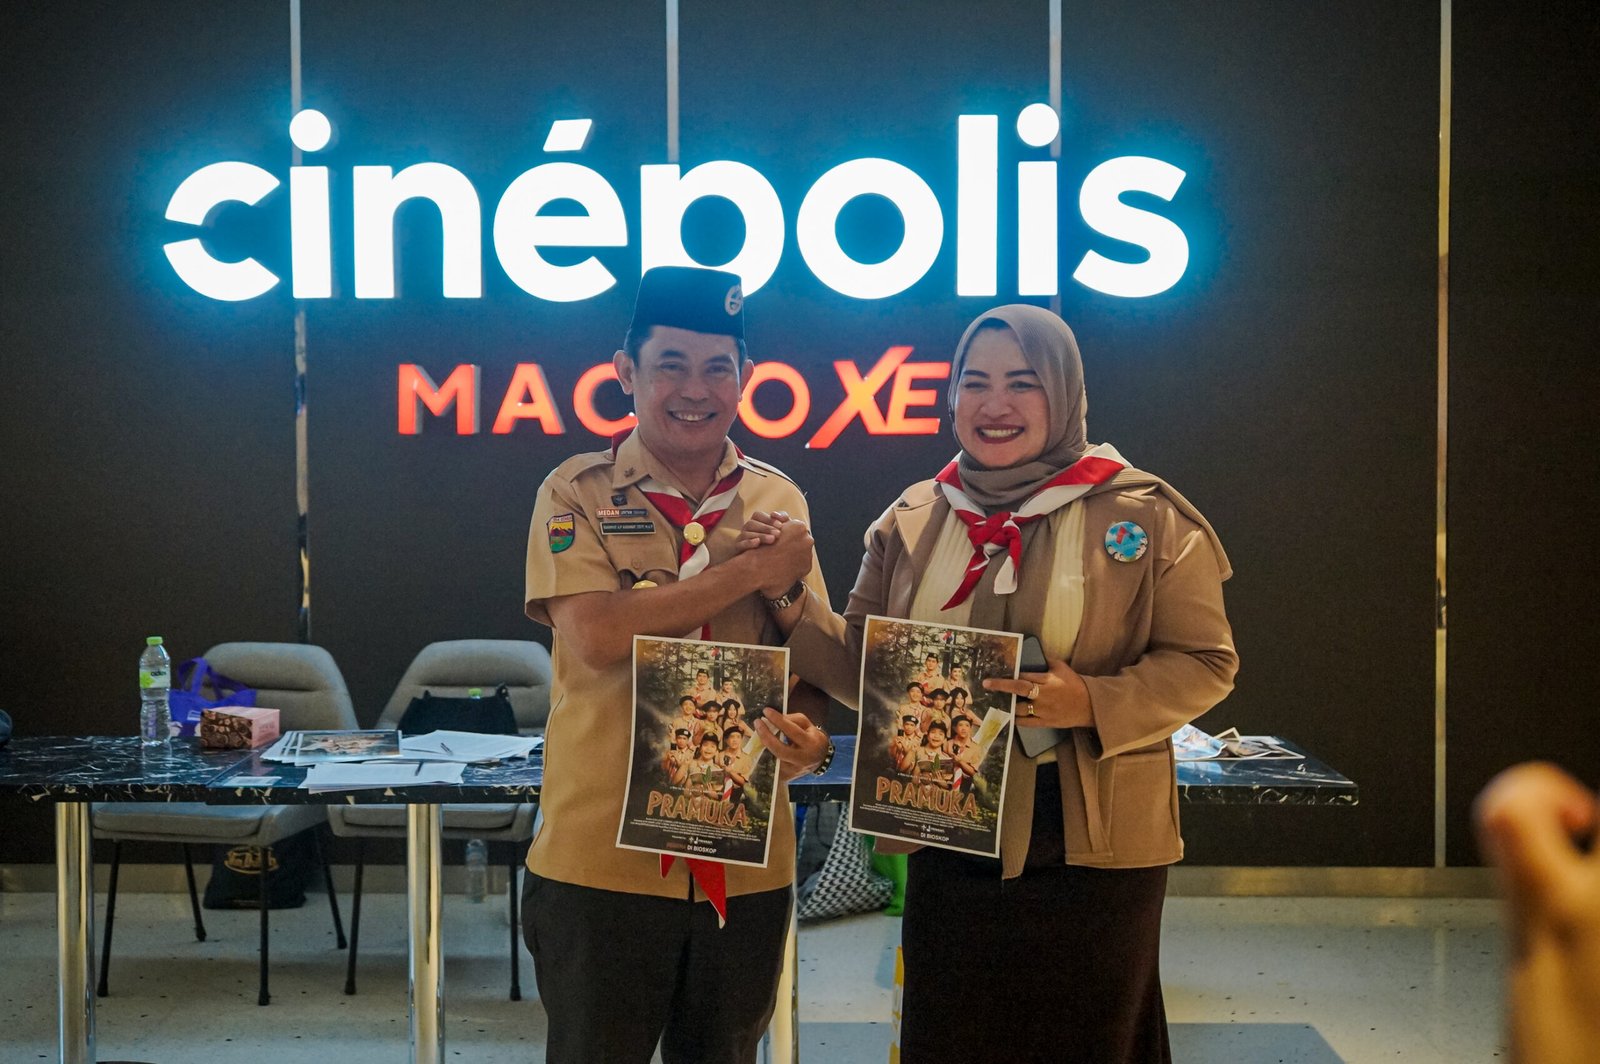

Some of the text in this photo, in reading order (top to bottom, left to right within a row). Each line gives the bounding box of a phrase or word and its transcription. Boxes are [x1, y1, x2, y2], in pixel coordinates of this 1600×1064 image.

[162, 102, 1190, 303] cinépolis
[398, 361, 811, 440] MACO
[646, 790, 747, 828] PRAMUKA
[875, 776, 977, 818] PRAMUKA
[693, 845, 717, 854] BIOSKOP
[926, 833, 950, 842] BIOSKOP
